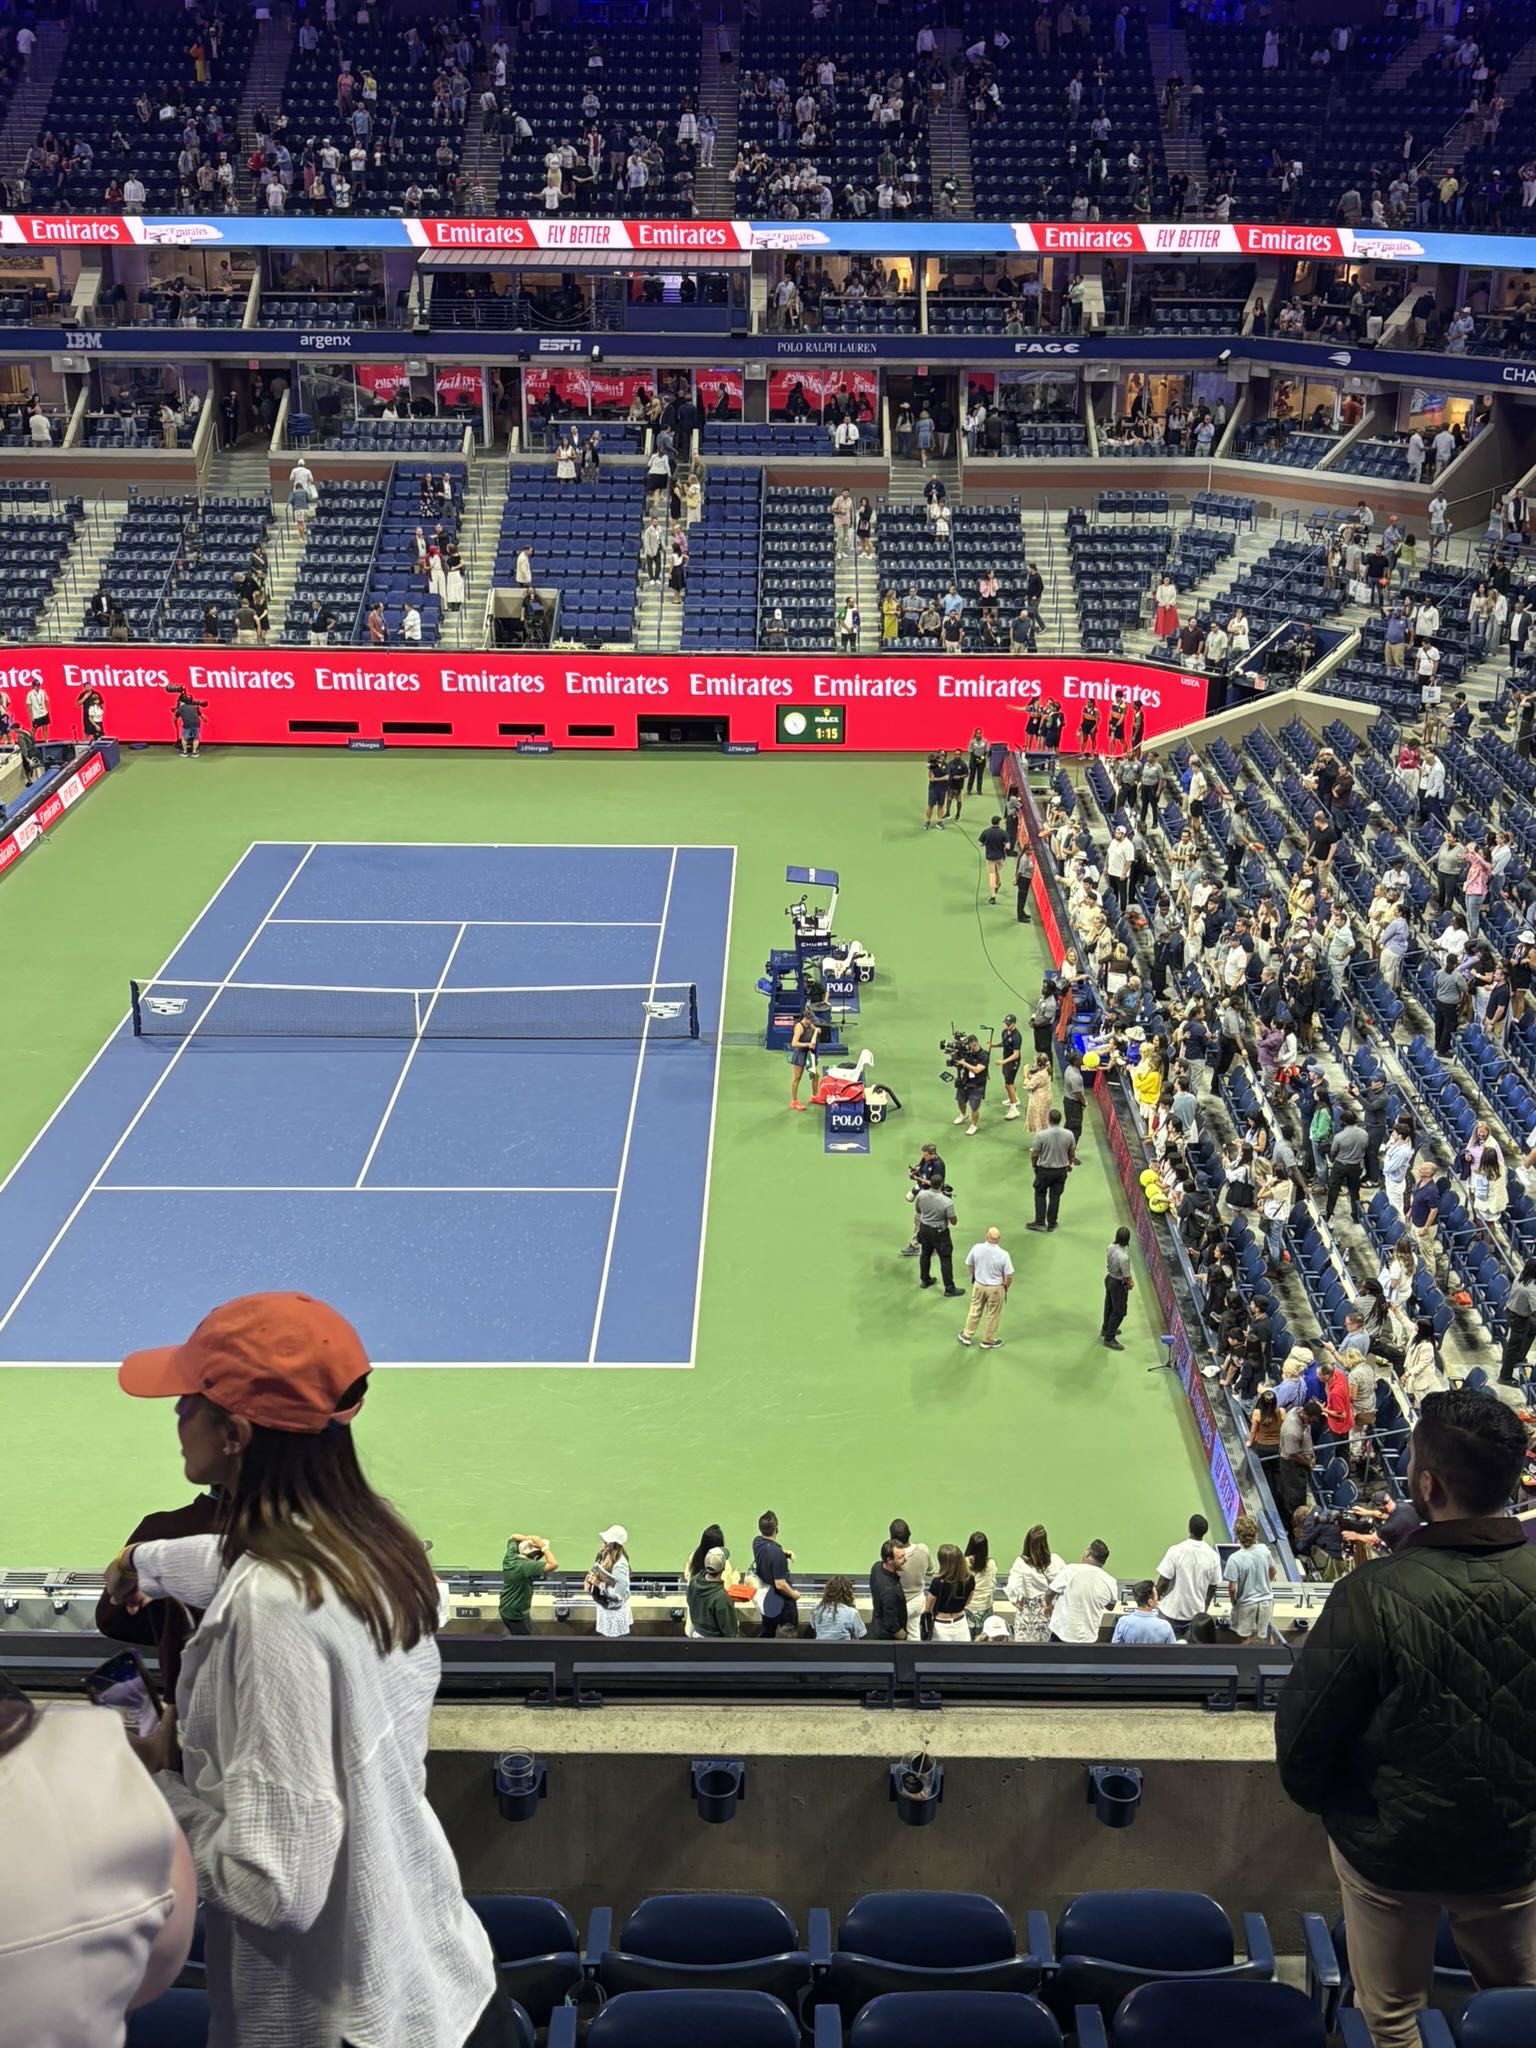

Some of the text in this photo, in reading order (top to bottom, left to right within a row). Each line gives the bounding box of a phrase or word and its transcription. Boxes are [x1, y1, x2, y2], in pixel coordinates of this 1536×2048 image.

[32, 219, 120, 240] Emirates
[436, 222, 524, 244] Emirates
[548, 225, 611, 244] FLY BETTER
[638, 224, 727, 246] Emirates
[1045, 228, 1133, 249] Emirates
[1156, 229, 1220, 248] FLY BETTER
[1248, 229, 1332, 252] Emirates
[66, 332, 102, 349] IBM
[299, 334, 351, 349] argenx
[538, 338, 582, 352] ESPN
[777, 342, 877, 353] POLO RALPH LAUREN
[1015, 343, 1080, 353] FAGE
[1502, 367, 1536, 383] CHA
[63, 665, 170, 687] Emirates
[189, 666, 295, 689] Emirates
[315, 667, 420, 691] Emirates
[440, 670, 545, 693] Emirates
[565, 671, 669, 695] Emirates
[689, 673, 793, 696] Emirates
[814, 675, 917, 697] Emirates
[938, 675, 1042, 697] Emirates
[1180, 677, 1201, 688] USTA
[1063, 676, 1161, 708] Emirates
[815, 727, 839, 740] 1:15
[827, 982, 854, 993] POLO
[832, 1114, 863, 1126] POLO
